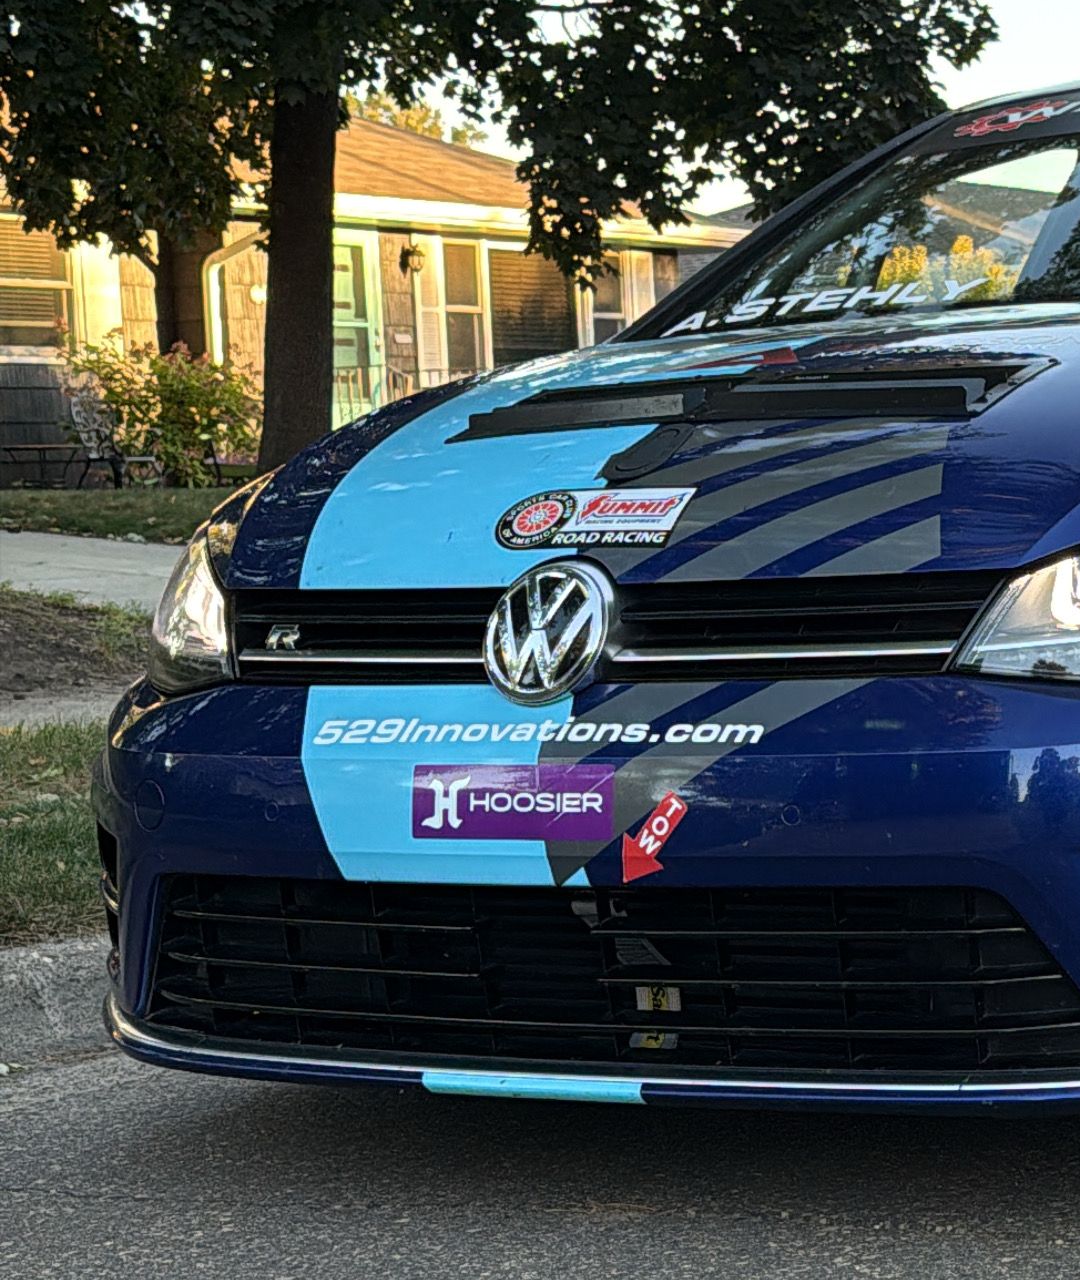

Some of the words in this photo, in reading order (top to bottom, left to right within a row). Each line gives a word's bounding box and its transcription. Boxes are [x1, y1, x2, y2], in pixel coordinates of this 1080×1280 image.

[507, 494, 545, 521] SPORTS
[551, 531, 600, 545] ROAD
[601, 531, 667, 544] RACING
[265, 624, 300, 650] R
[313, 716, 764, 745] 529Innovations.com
[469, 791, 603, 813] HOOSIER
[639, 797, 682, 855] TOW
